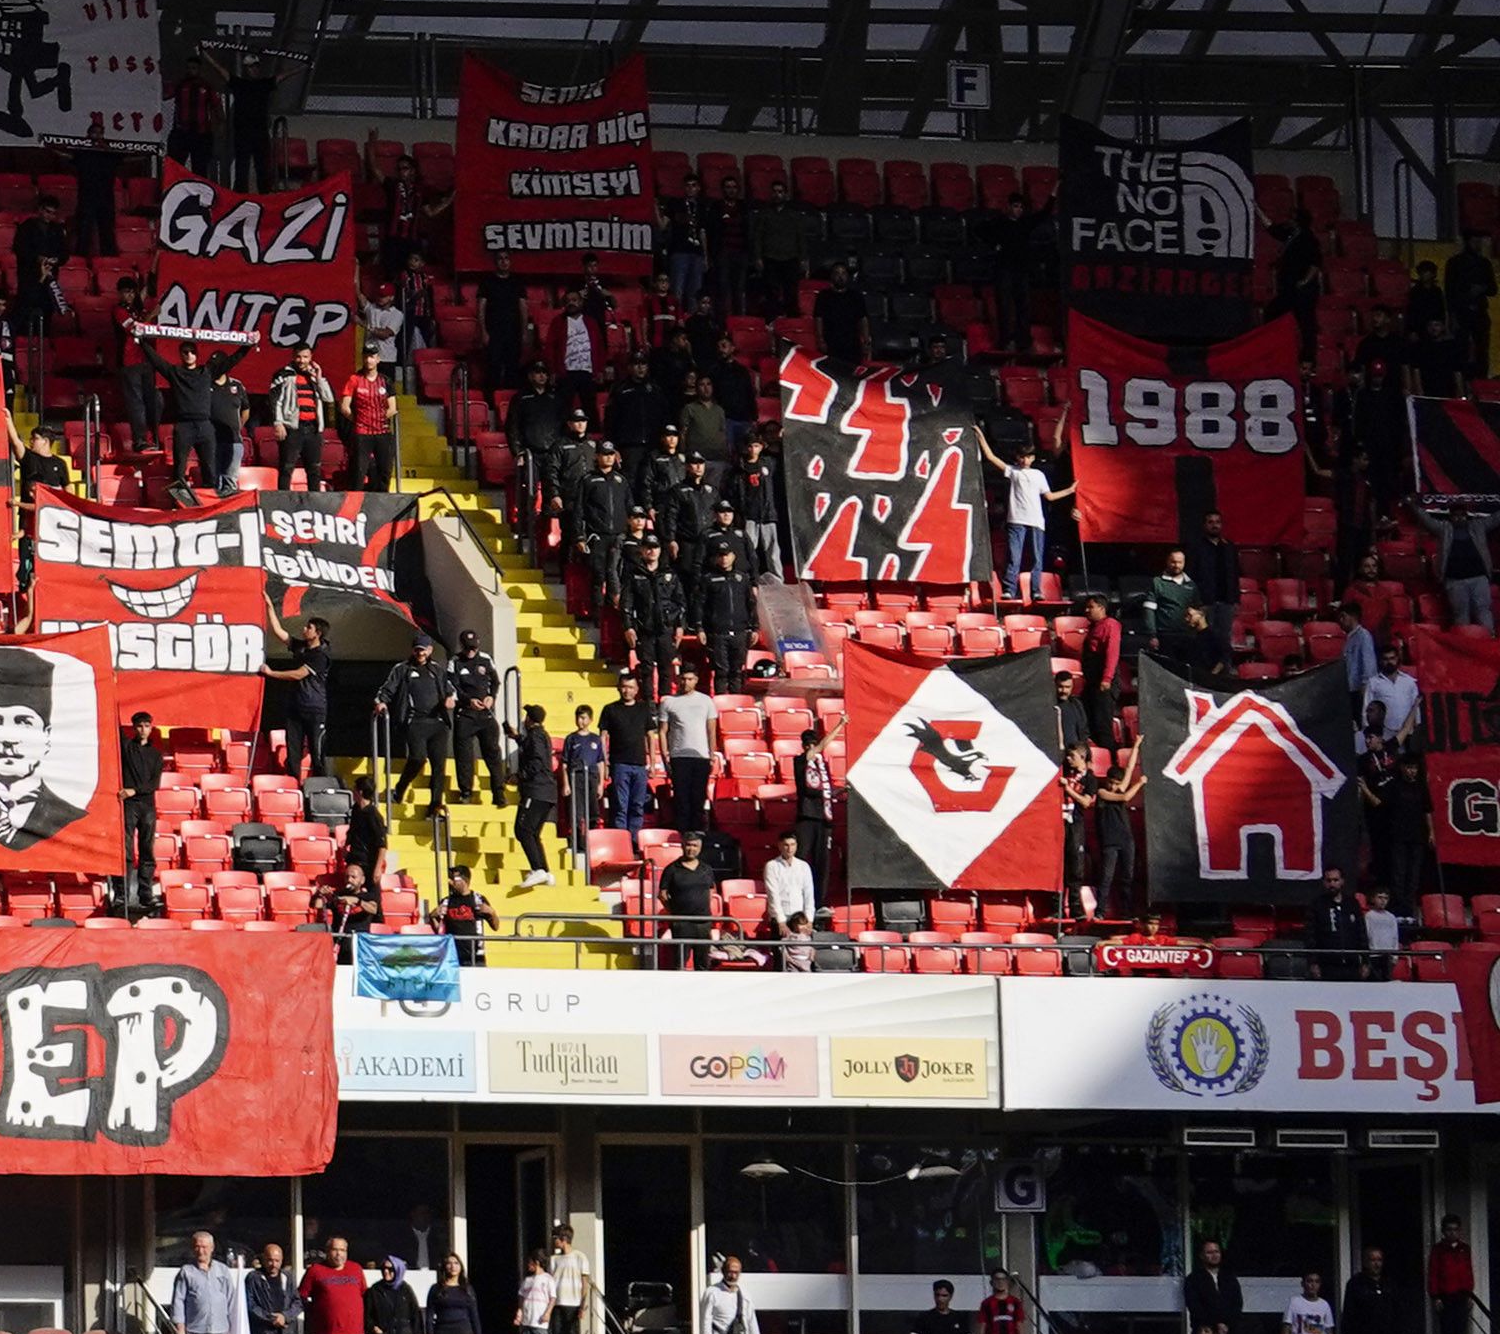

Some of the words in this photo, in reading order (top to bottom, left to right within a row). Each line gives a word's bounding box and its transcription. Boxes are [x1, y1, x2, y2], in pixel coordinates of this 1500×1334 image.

[957, 69, 978, 103] F
[487, 117, 590, 151] KADAR
[597, 111, 648, 149] HİÇ
[510, 164, 641, 198] KİMSEYİ
[1095, 144, 1179, 184] THE
[1117, 187, 1178, 216] NO
[160, 179, 348, 264] GAZİ
[484, 218, 652, 253] SEVMEDİM
[1072, 217, 1179, 254] FACE
[158, 284, 349, 349] ANTEP
[1079, 369, 1298, 454] 1988
[272, 509, 368, 545] ŞEHRİ
[517, 1039, 618, 1087] Tudyahan
[690, 1055, 785, 1080] GOPSM
[842, 1057, 891, 1078] JOLLY
[921, 1059, 975, 1078] JOKER
